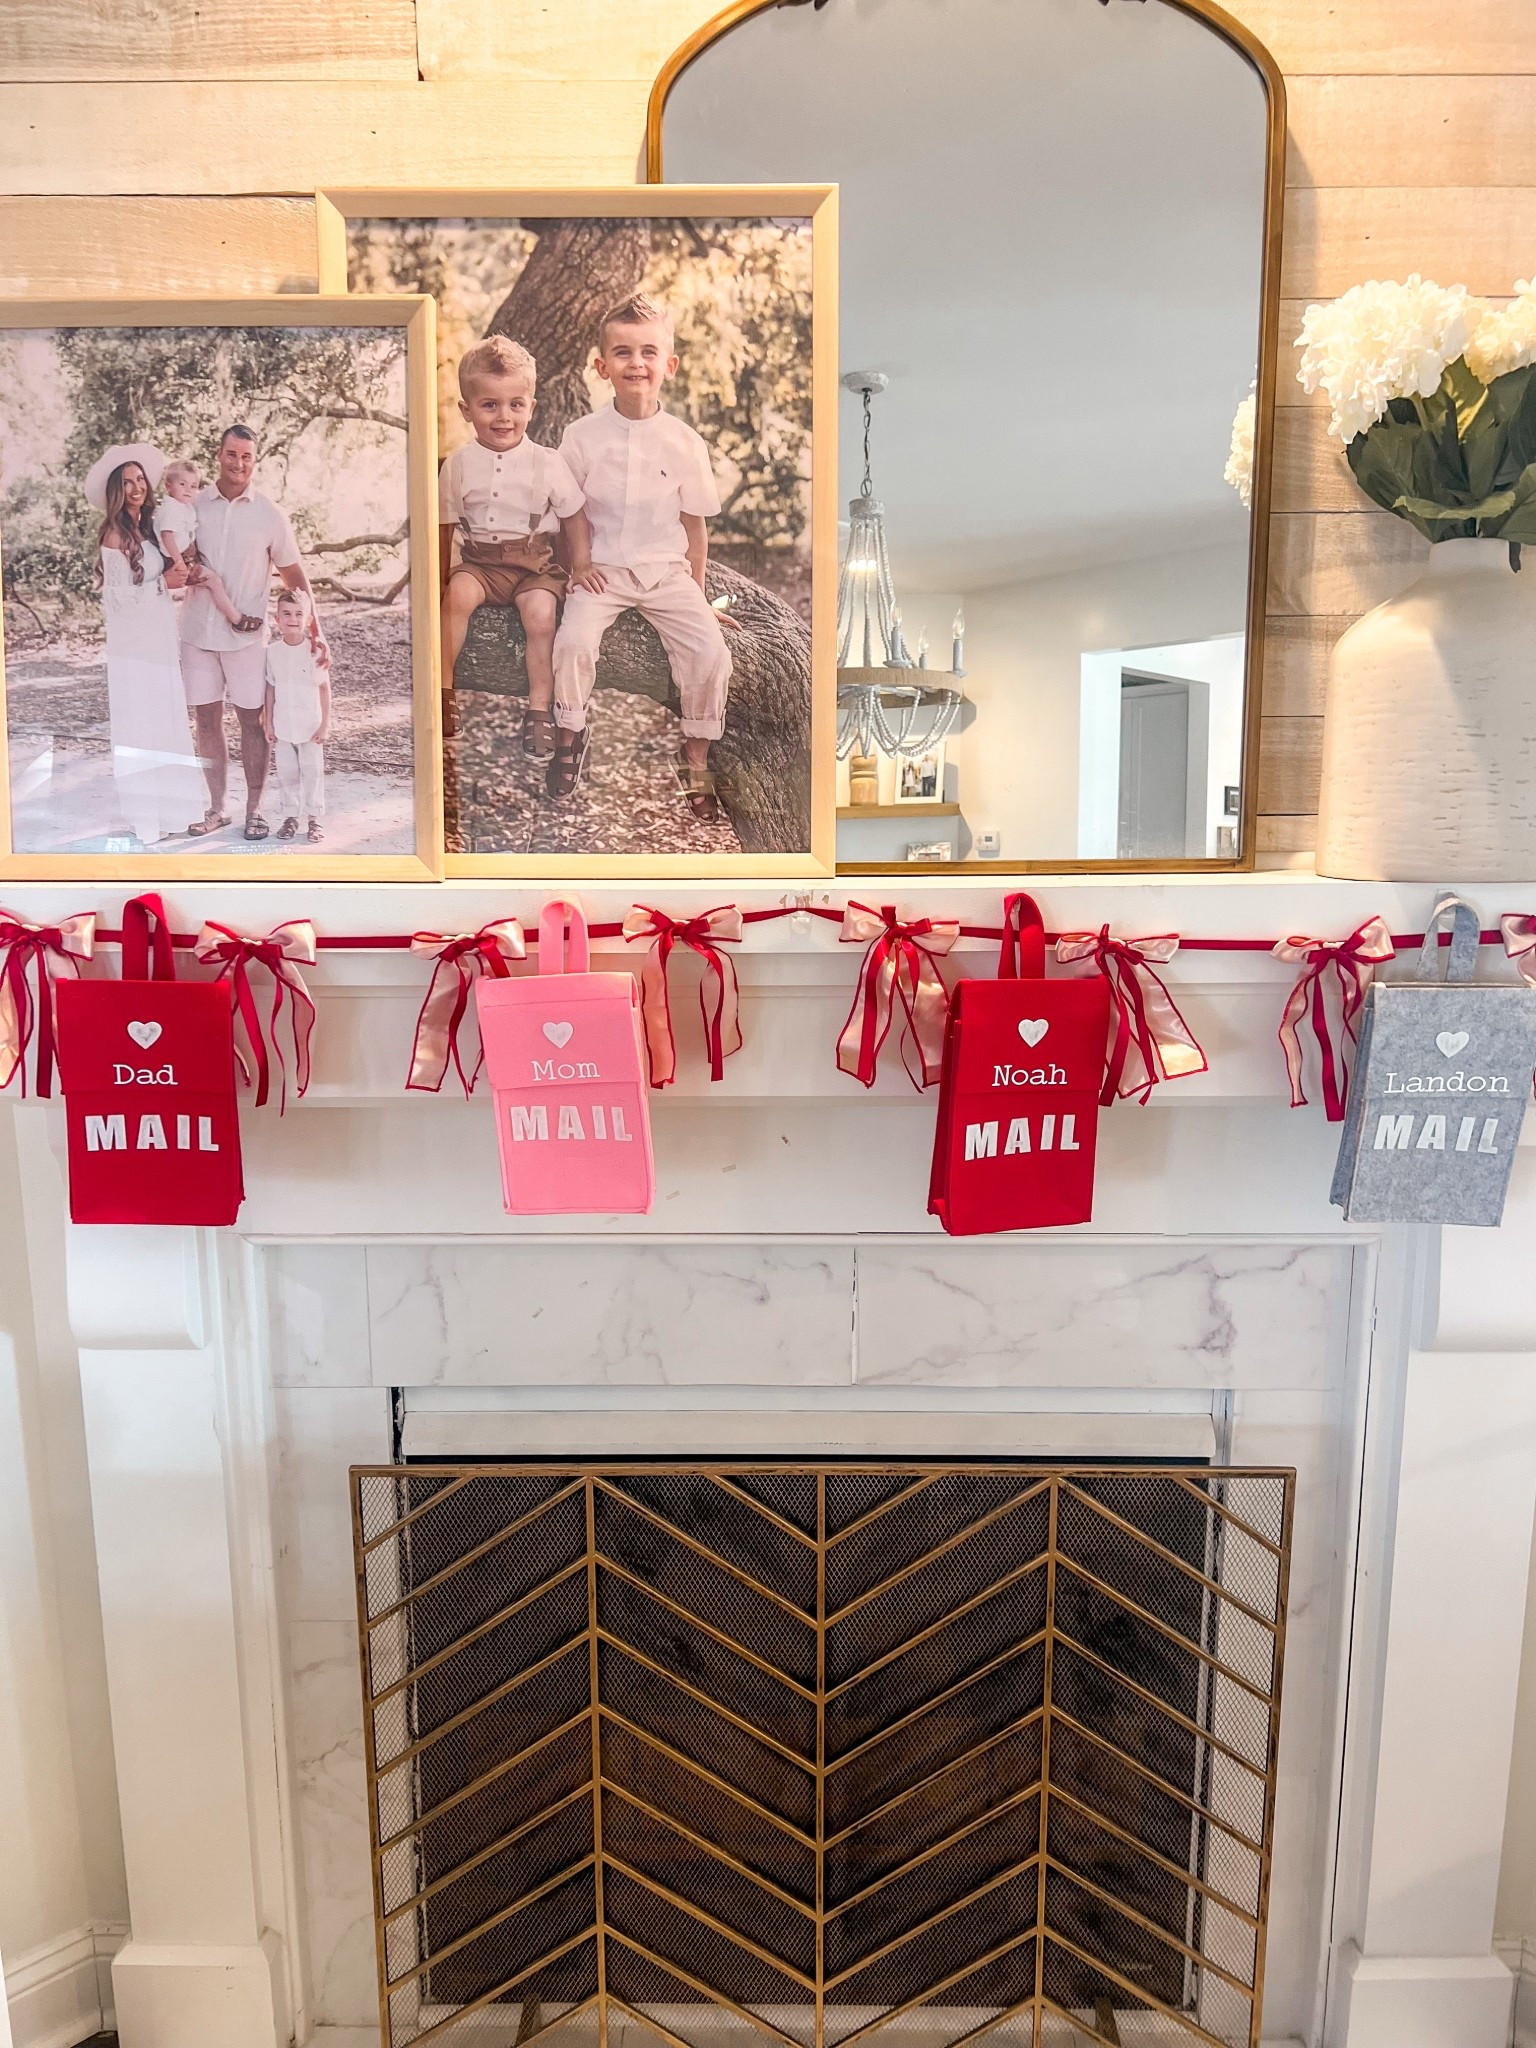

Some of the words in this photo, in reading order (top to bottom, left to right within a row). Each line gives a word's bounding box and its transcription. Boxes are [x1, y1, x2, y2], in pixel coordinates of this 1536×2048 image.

[113, 1064, 178, 1085] Dad
[531, 1060, 600, 1081] Mom
[992, 1064, 1067, 1087] Noah
[1384, 1072, 1510, 1093] Landon
[85, 1114, 219, 1151] MAIL
[510, 1105, 633, 1142] MAIL
[964, 1114, 1080, 1161] MAIL
[1373, 1114, 1499, 1154] MAIL
